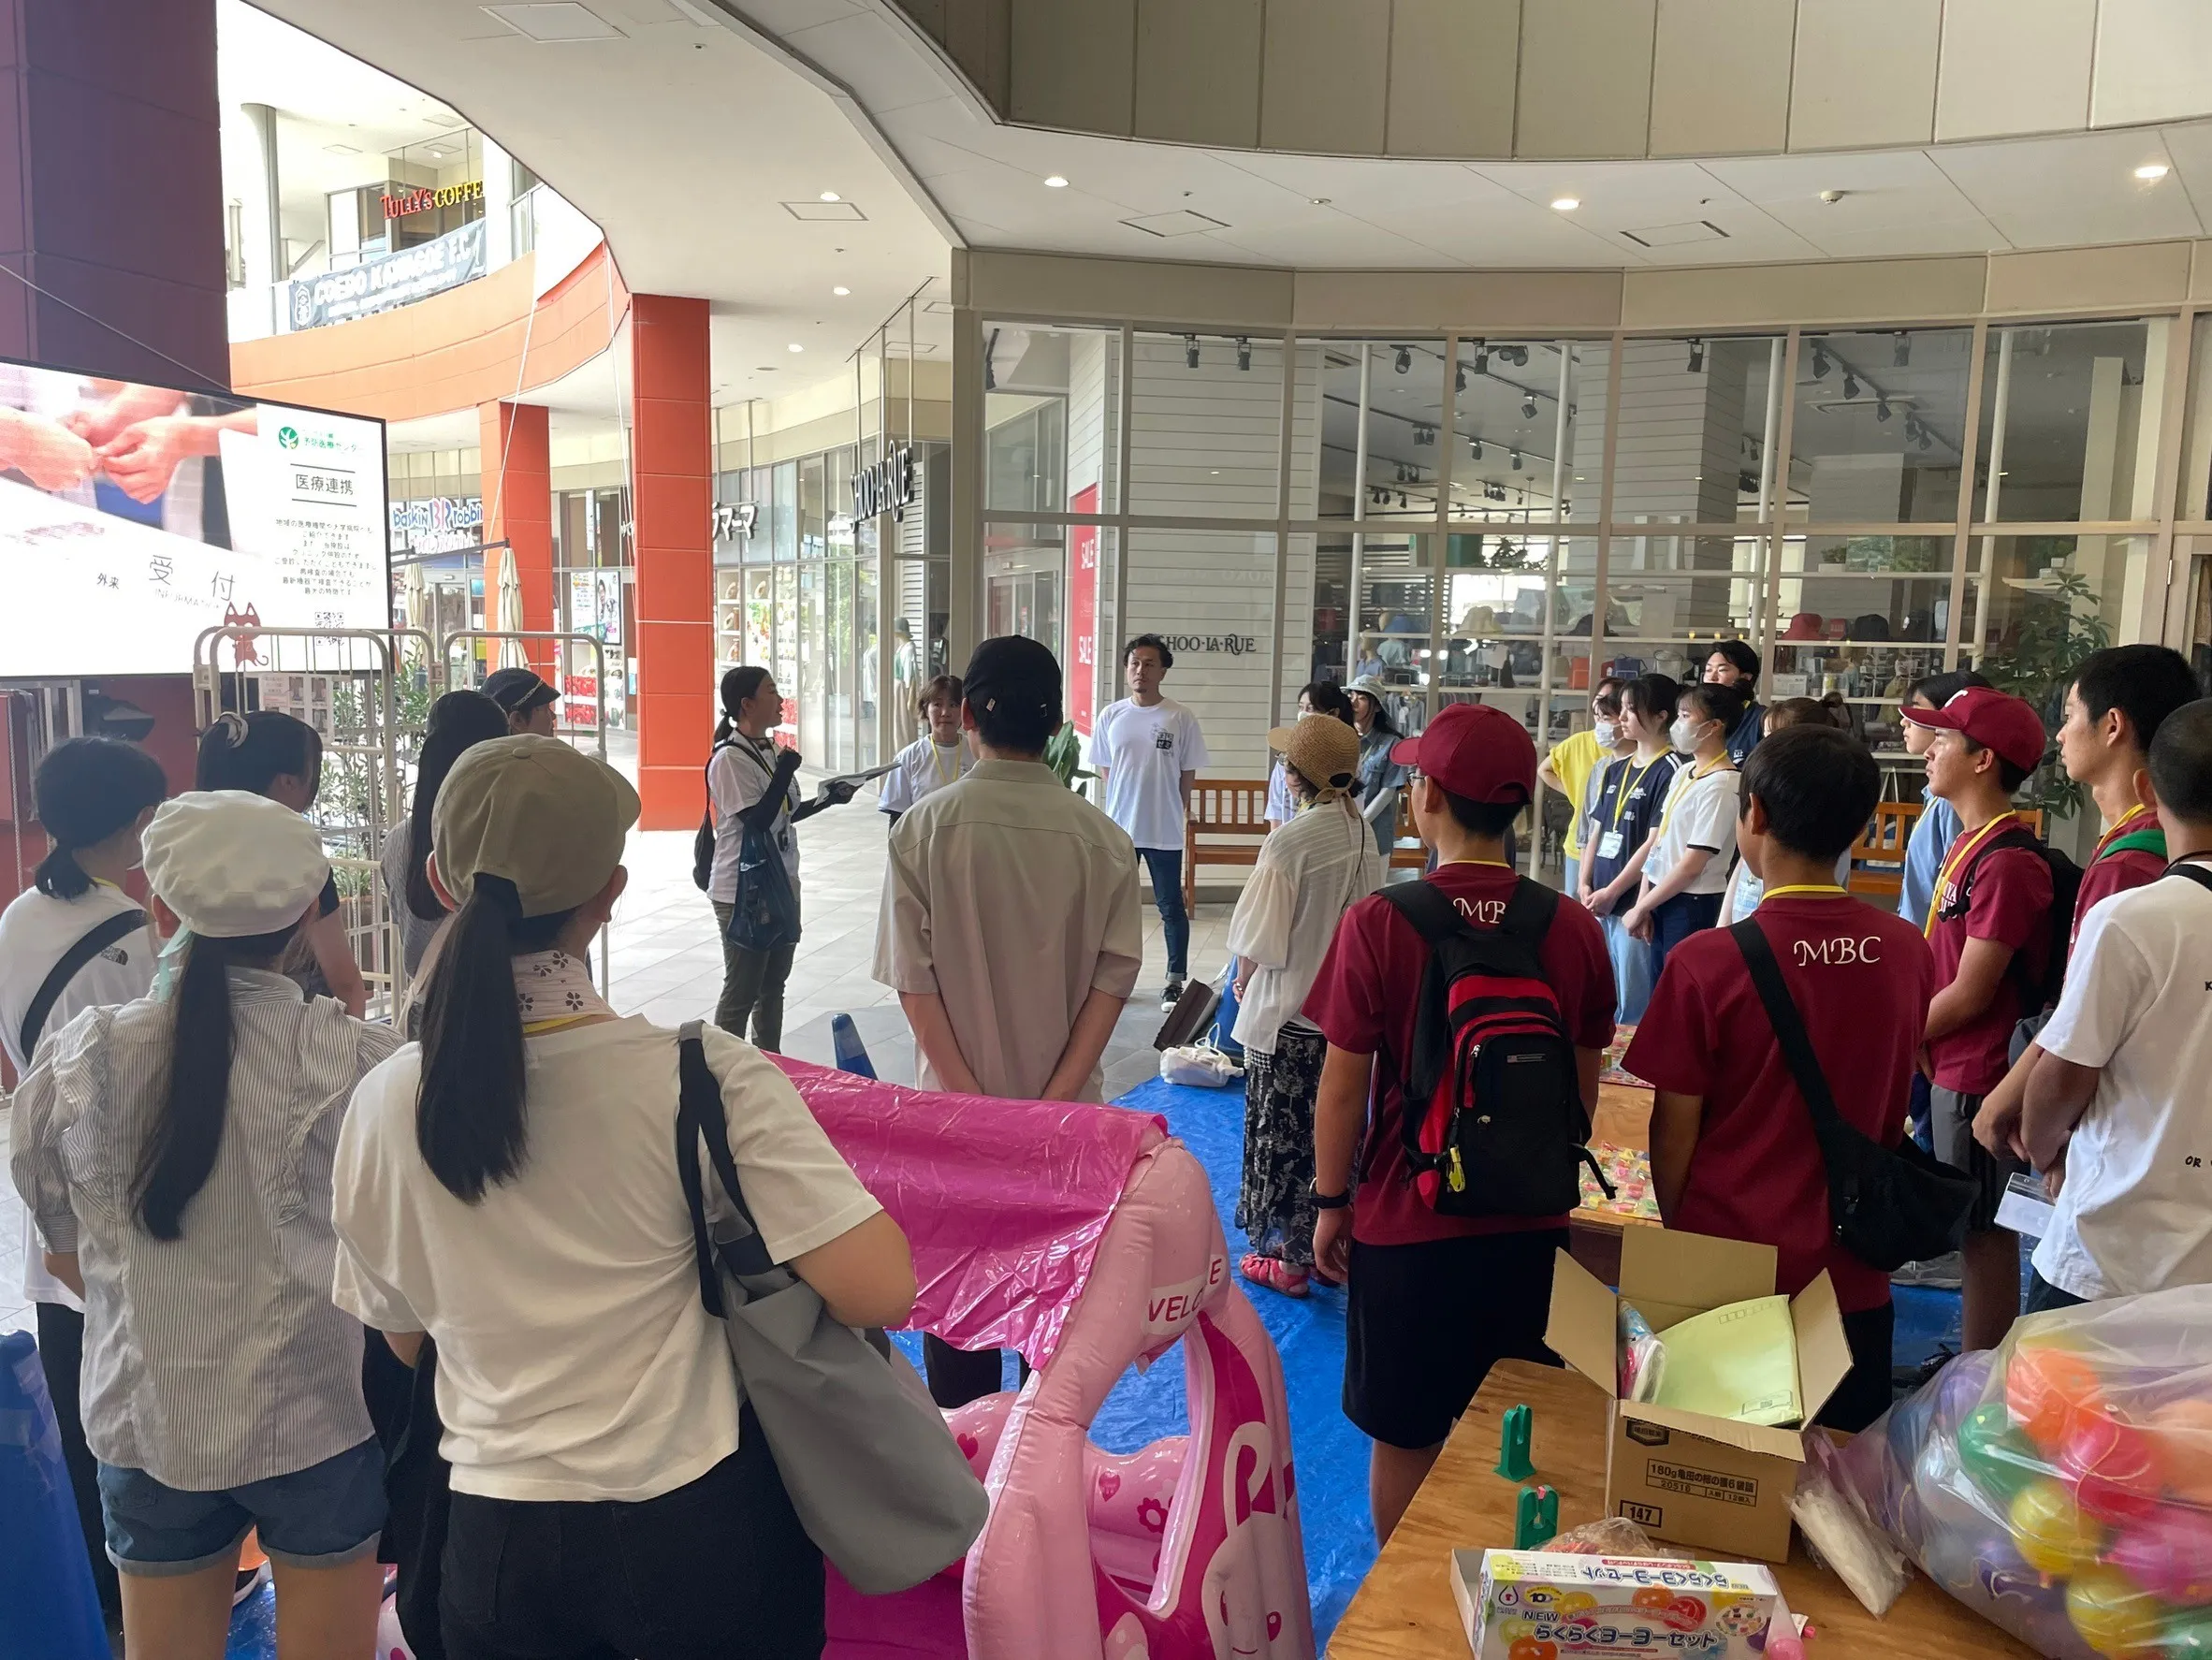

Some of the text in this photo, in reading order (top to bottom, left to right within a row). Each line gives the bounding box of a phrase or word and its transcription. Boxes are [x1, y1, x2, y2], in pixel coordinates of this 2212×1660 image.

[296, 473, 354, 496] 医療連携
[96, 573, 120, 590] 外来
[1793, 936, 1882, 968] MBC
[2185, 1155, 2202, 1169] OR
[1629, 1506, 1652, 1522] 147
[1522, 1609, 1560, 1622] NEW
[1535, 1623, 1718, 1650] らくらくヨーヨーセット
